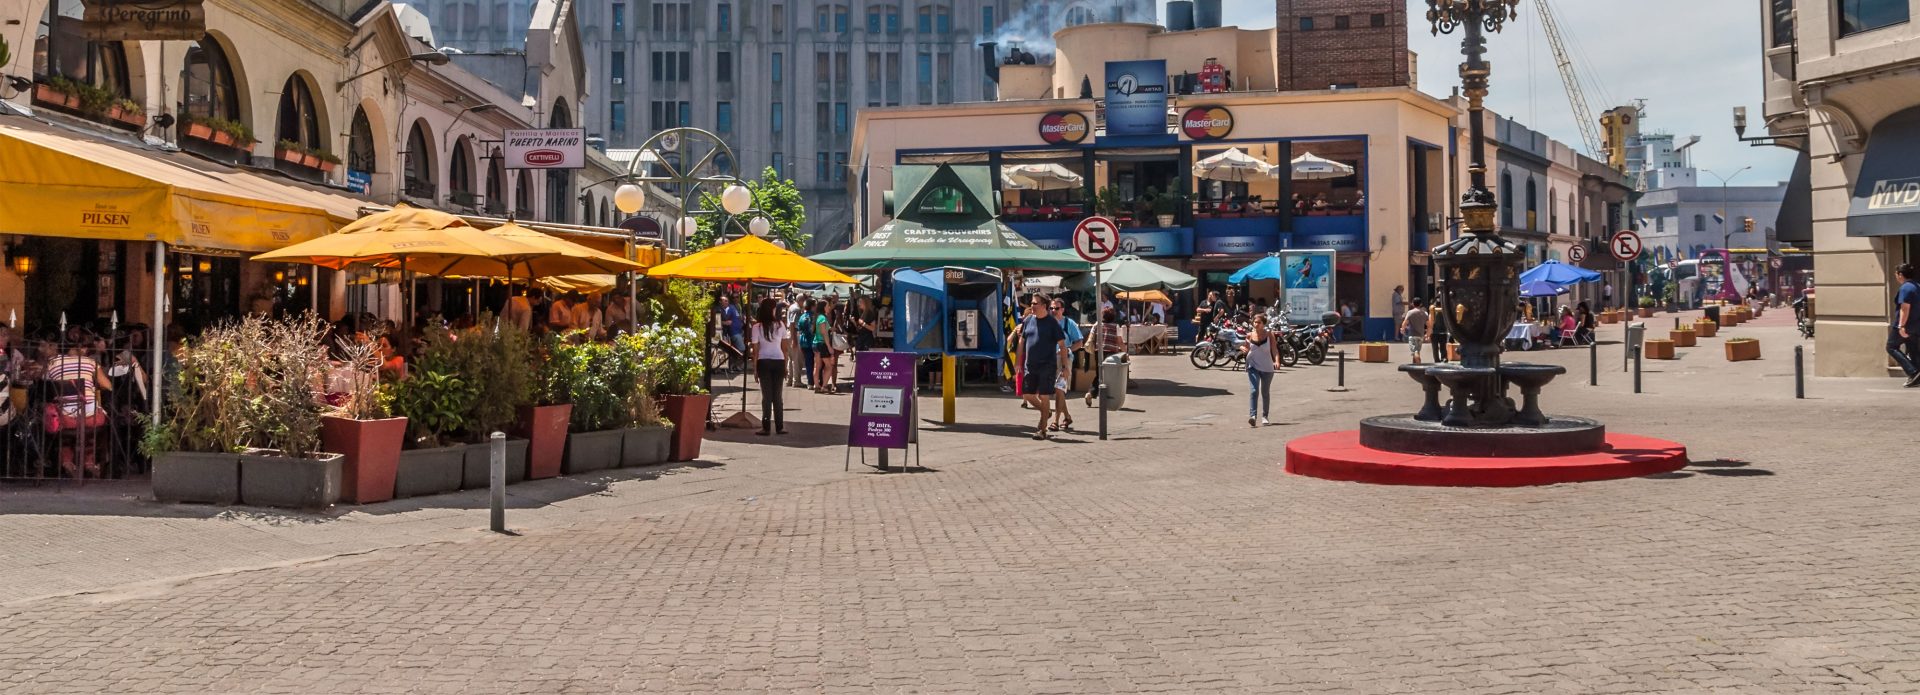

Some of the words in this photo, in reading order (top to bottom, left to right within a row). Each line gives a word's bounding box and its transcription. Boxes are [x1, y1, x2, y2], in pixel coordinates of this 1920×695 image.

[102, 7, 190, 31] Peregrino
[1042, 123, 1085, 133] MasterCard
[1185, 118, 1230, 128] MasterCard
[510, 138, 543, 147] PUERTO
[545, 138, 579, 146] MARINO
[1868, 180, 1920, 209] MVD
[81, 212, 130, 226] PILSEN
[191, 222, 211, 235] PILSEN
[272, 230, 290, 241] PILSEN
[949, 236, 993, 245] Uruguay
[1088, 227, 1106, 253] E
[1620, 237, 1632, 254] E
[945, 271, 964, 279] antel
